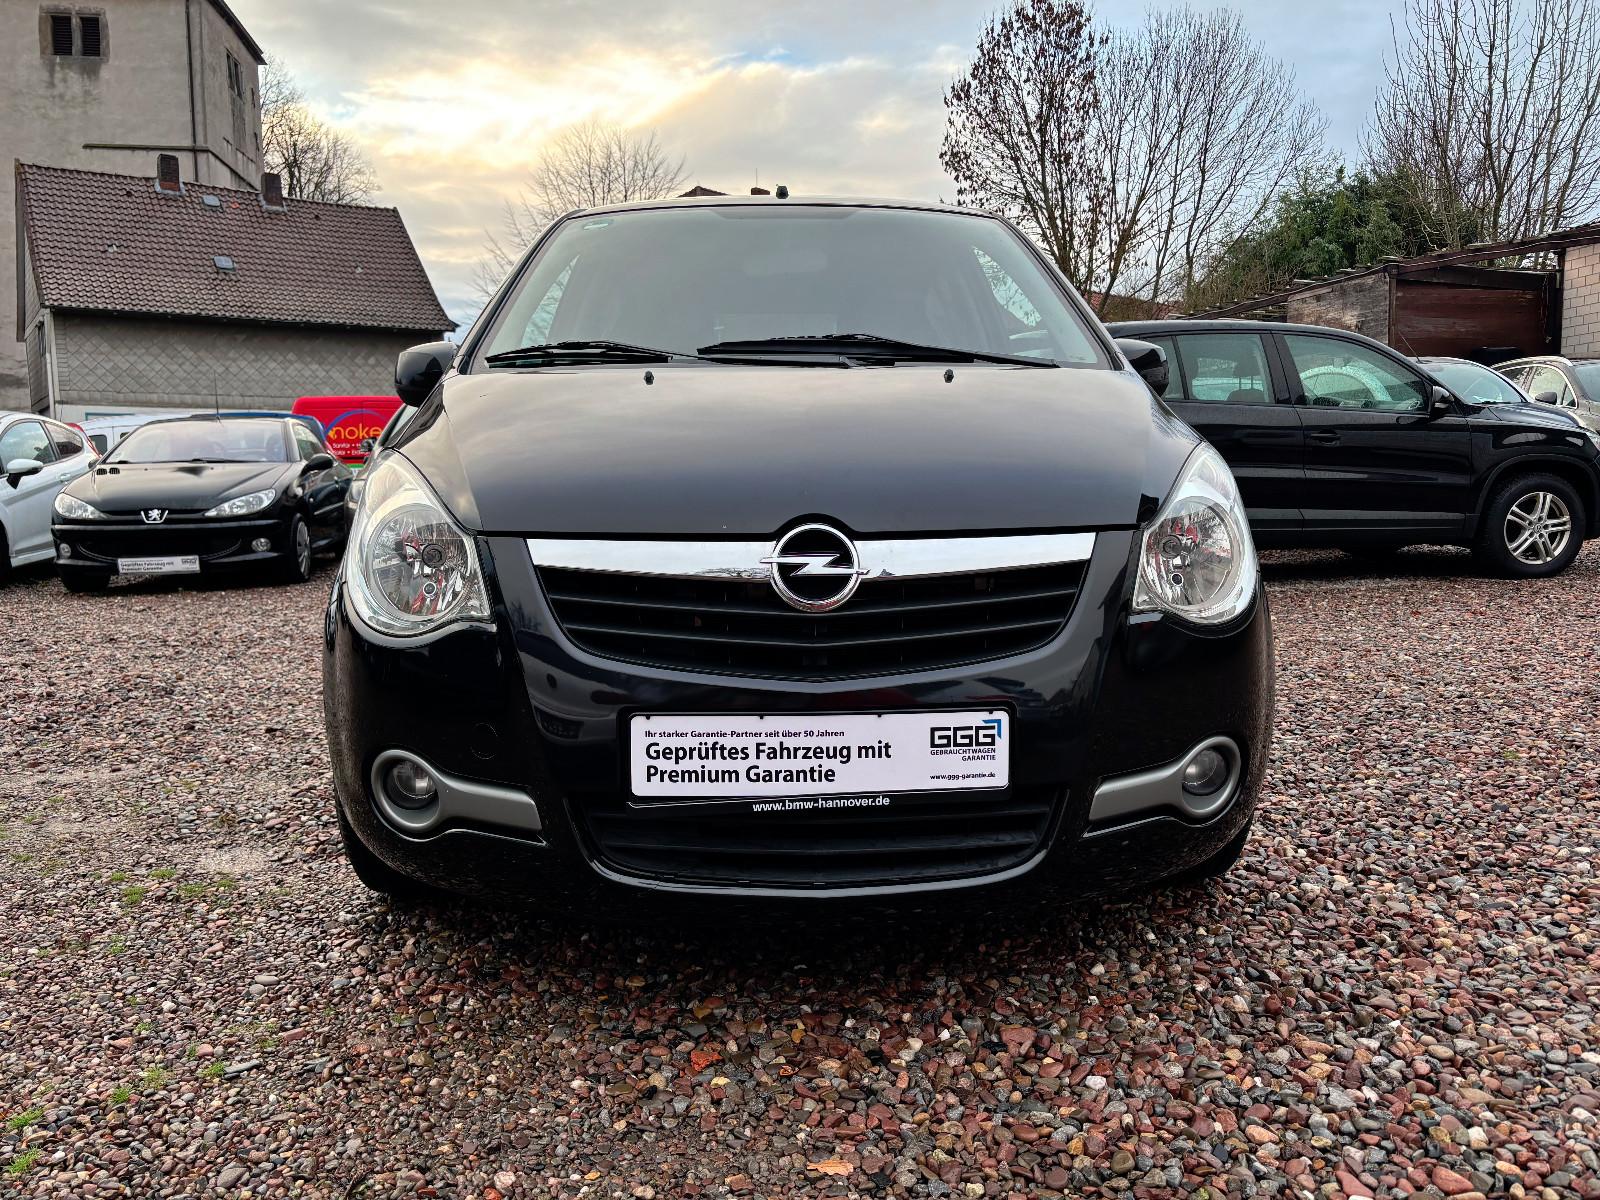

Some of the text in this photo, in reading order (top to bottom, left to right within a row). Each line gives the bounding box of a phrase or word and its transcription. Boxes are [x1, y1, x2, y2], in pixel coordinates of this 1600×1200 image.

[645, 729, 845, 738] Ihr starker Garantie-Partner seit über 50 Jahren
[930, 725, 996, 748] GGG
[645, 740, 892, 765] Geprüftes Fahrzeug mit
[930, 747, 996, 756] GEBRAUCHTWAGEN
[646, 764, 836, 783] Premium Garantie
[929, 772, 996, 780] www.ggg-garantie.de
[752, 796, 891, 812] www.bmw-hannover.de
